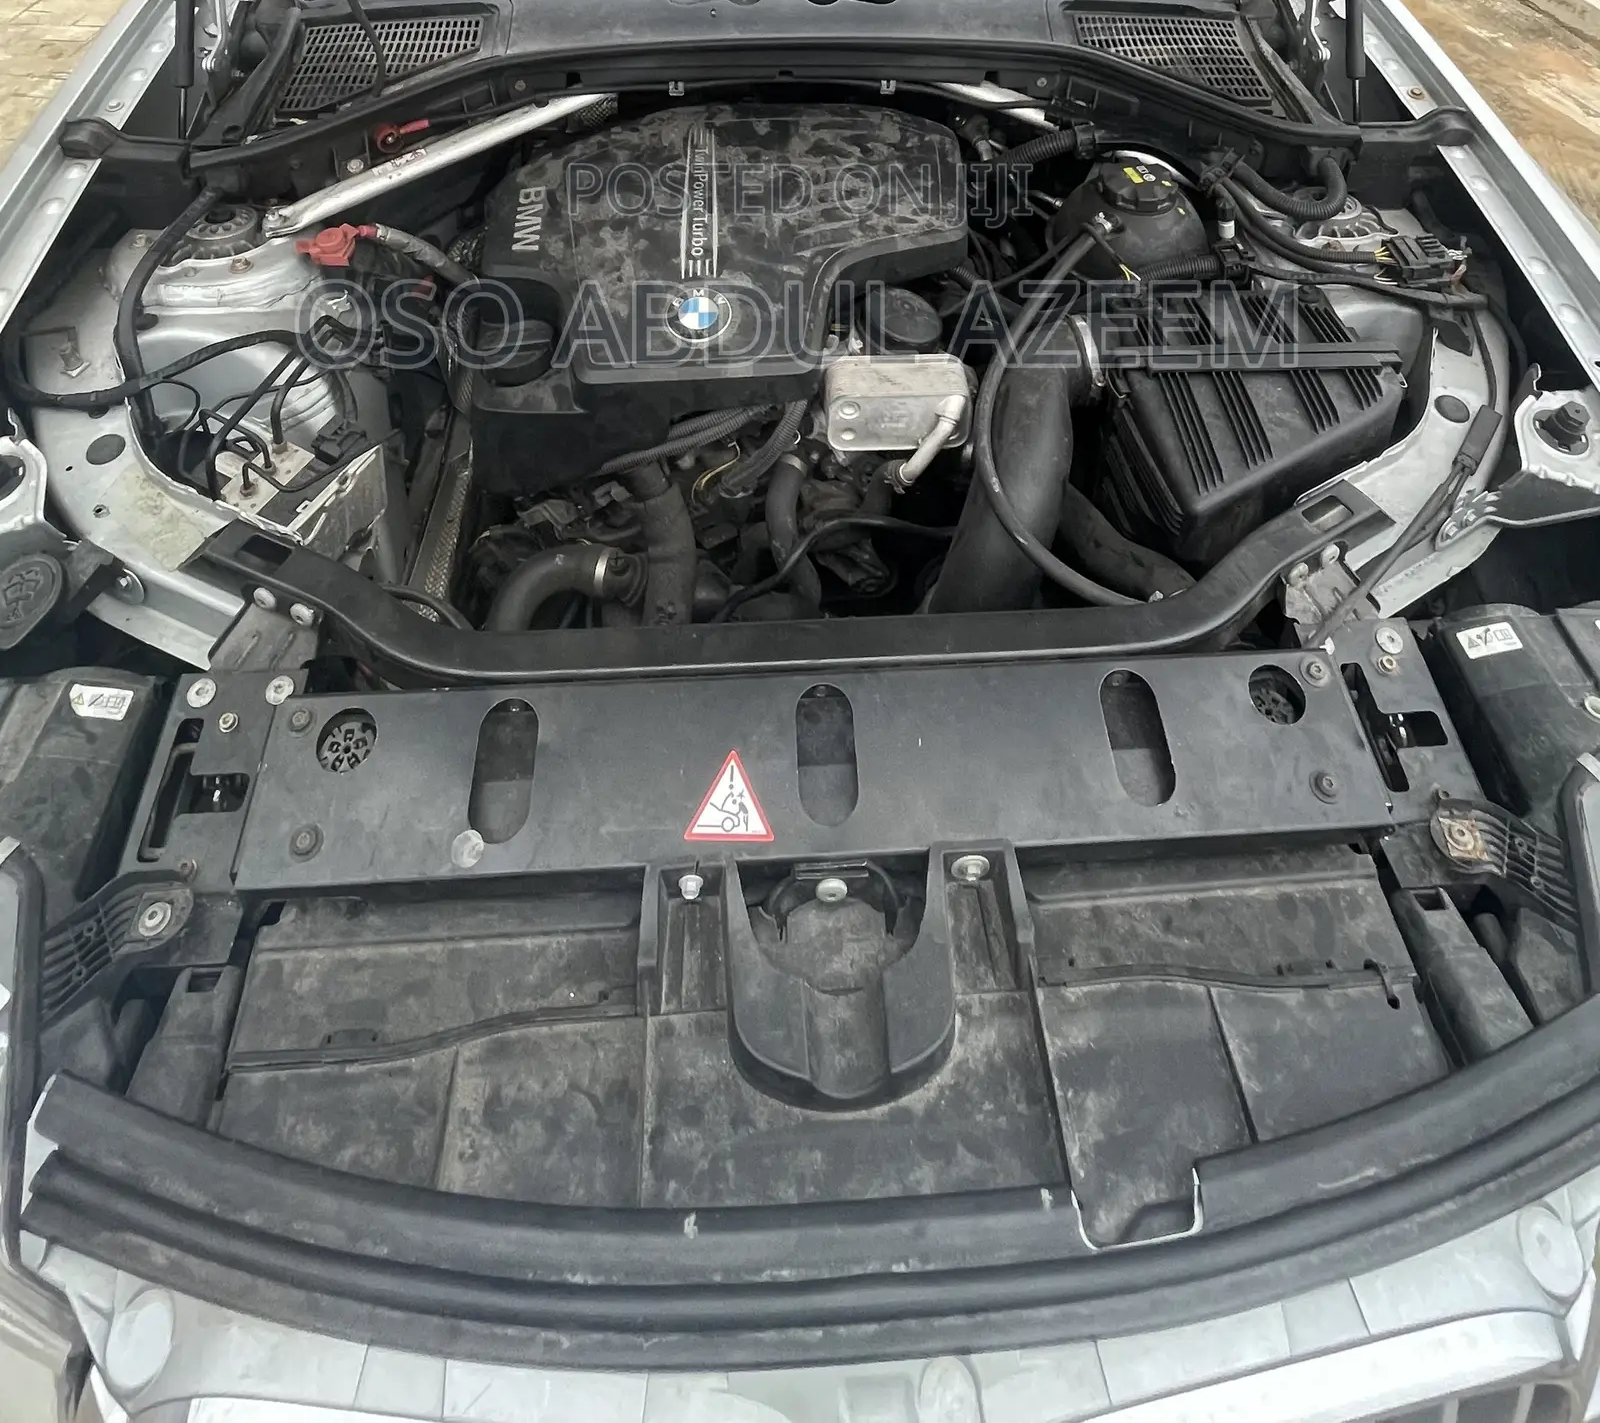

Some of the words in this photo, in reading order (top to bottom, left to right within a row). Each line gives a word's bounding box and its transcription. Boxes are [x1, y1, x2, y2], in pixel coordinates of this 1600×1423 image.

[693, 146, 709, 213] TwinPower
[511, 185, 547, 253] BMW
[690, 214, 708, 257] Turbo
[672, 289, 727, 308] BMW
